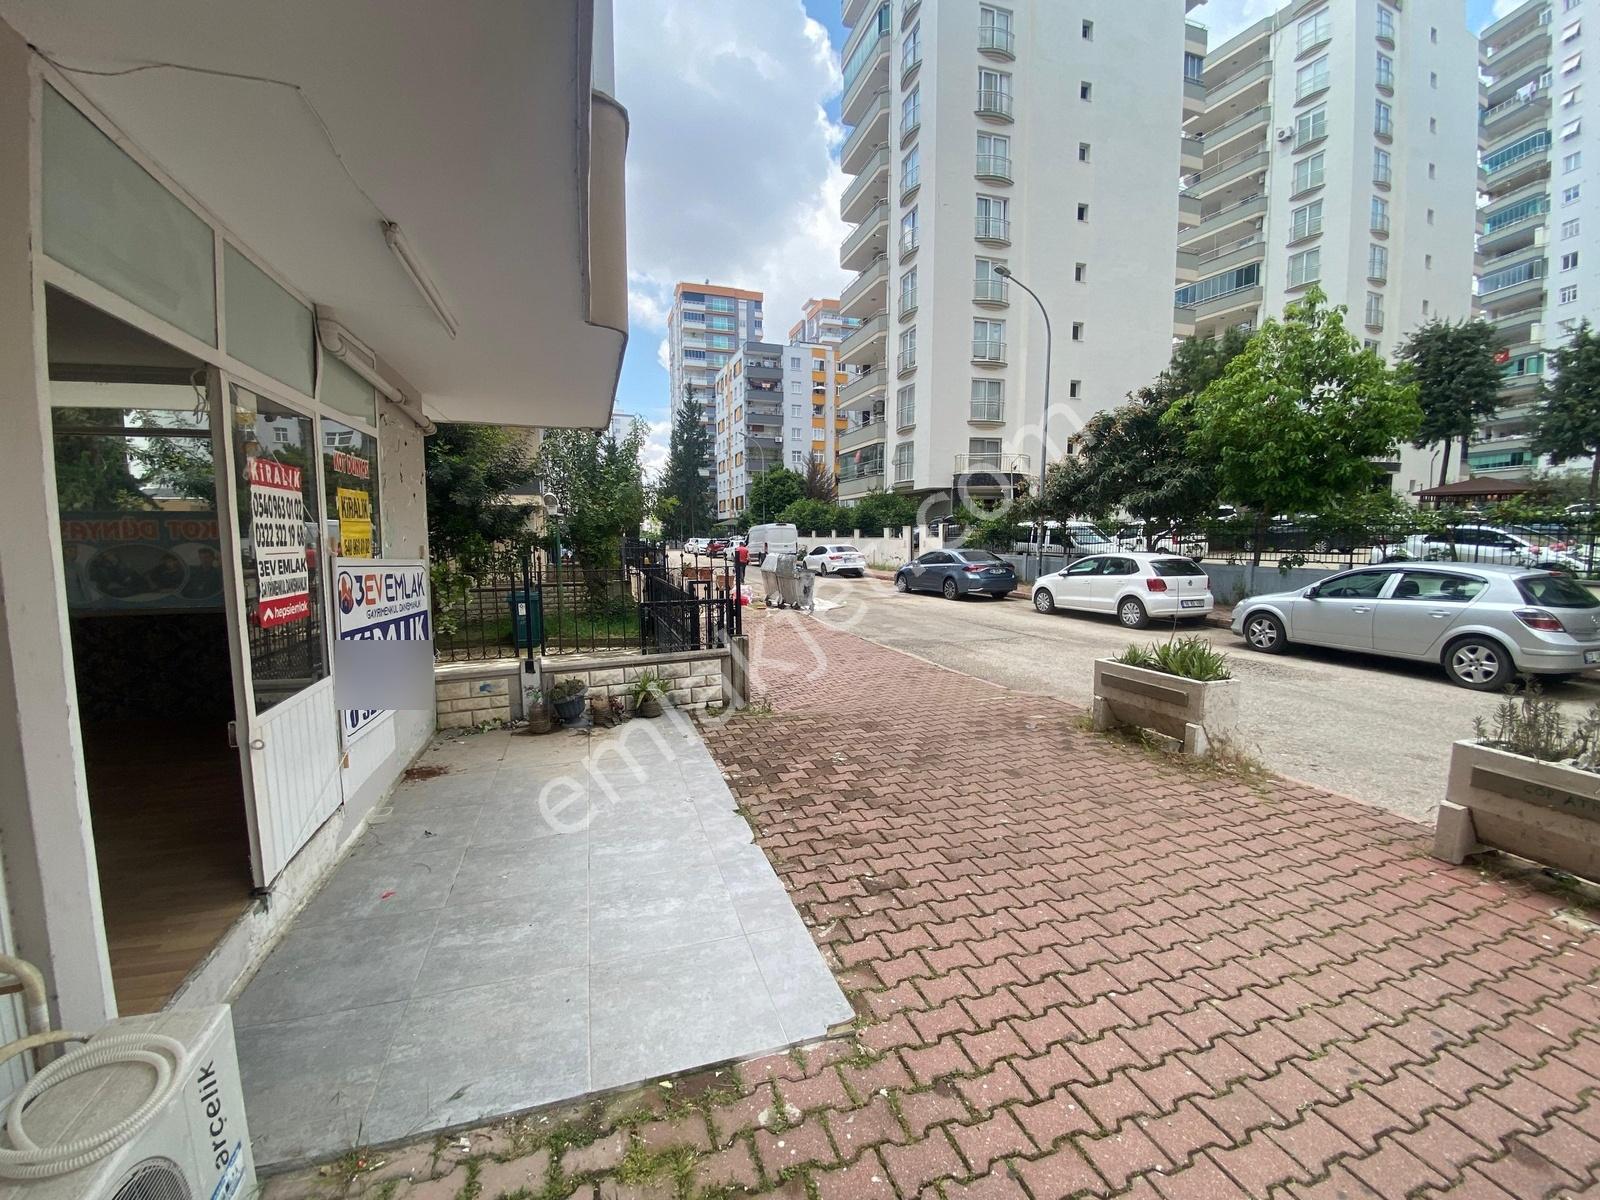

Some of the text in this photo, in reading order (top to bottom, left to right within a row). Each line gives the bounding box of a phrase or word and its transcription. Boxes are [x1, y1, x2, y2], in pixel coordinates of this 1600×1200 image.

[256, 522, 274, 547] 0322
[275, 523, 287, 547] 322
[288, 524, 295, 546] 19
[259, 558, 307, 578] 3EV EMLAK
[354, 572, 425, 607] 3EV EMLAK
[274, 600, 308, 619] hepsiemlak
